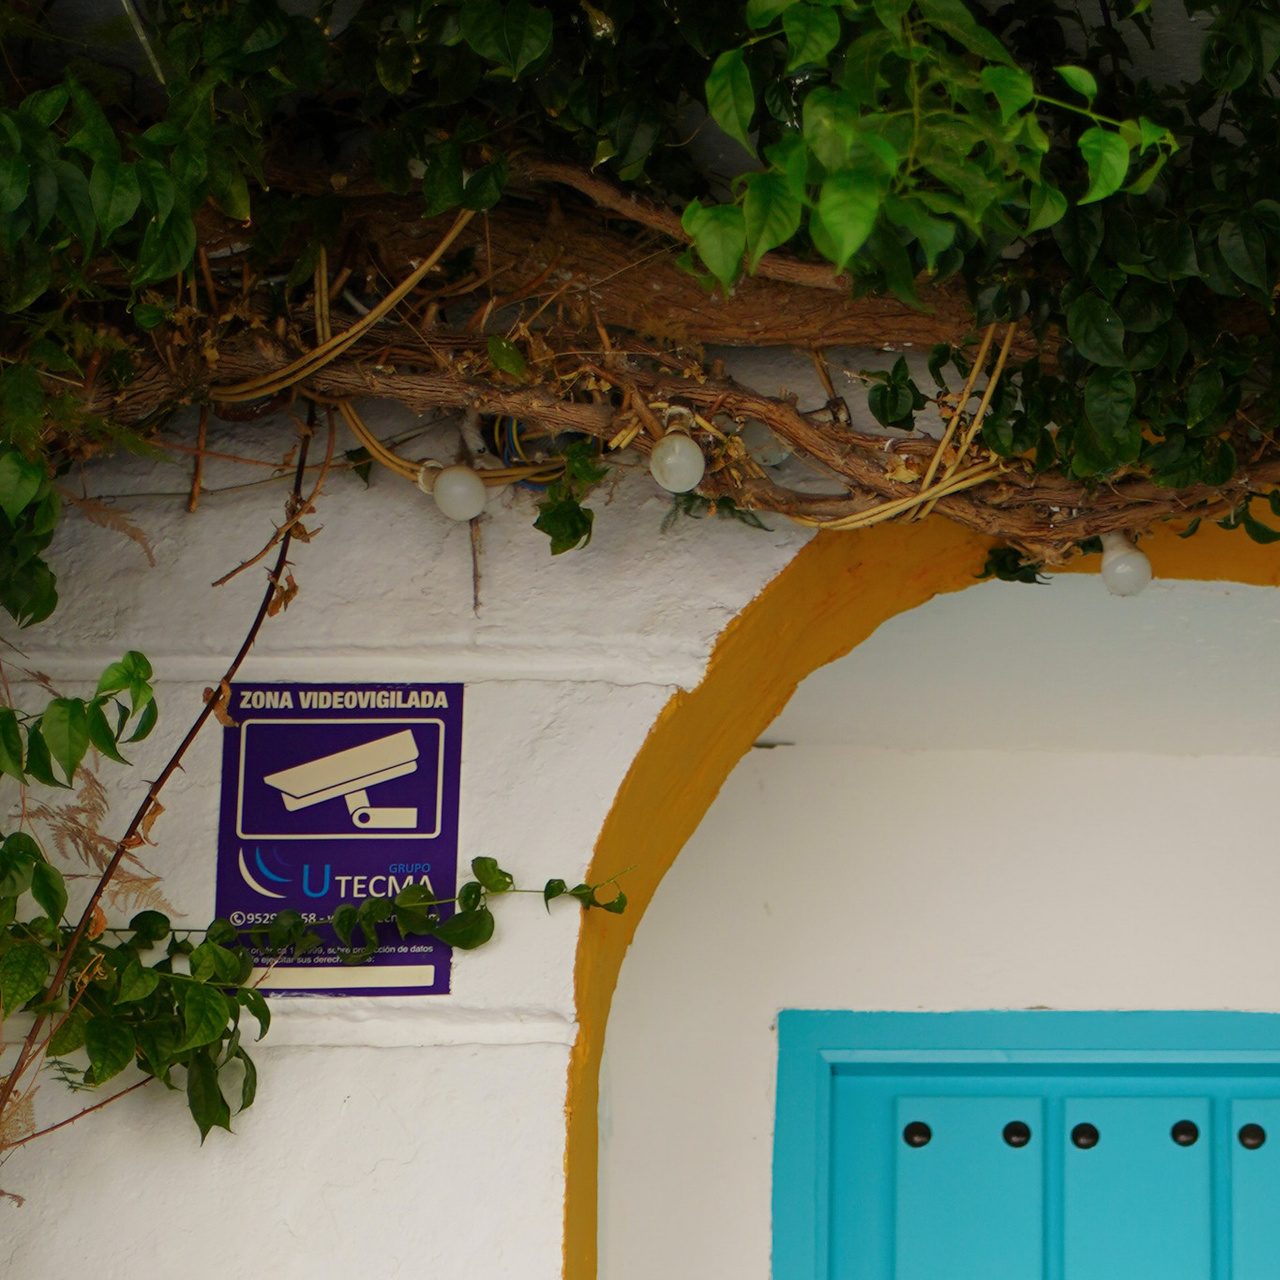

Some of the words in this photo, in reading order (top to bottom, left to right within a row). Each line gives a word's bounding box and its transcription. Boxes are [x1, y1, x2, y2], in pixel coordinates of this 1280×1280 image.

[239, 690, 294, 709] ZONA
[299, 690, 449, 709] VIDEOVIGILADA
[389, 863, 431, 873] GRUPO
